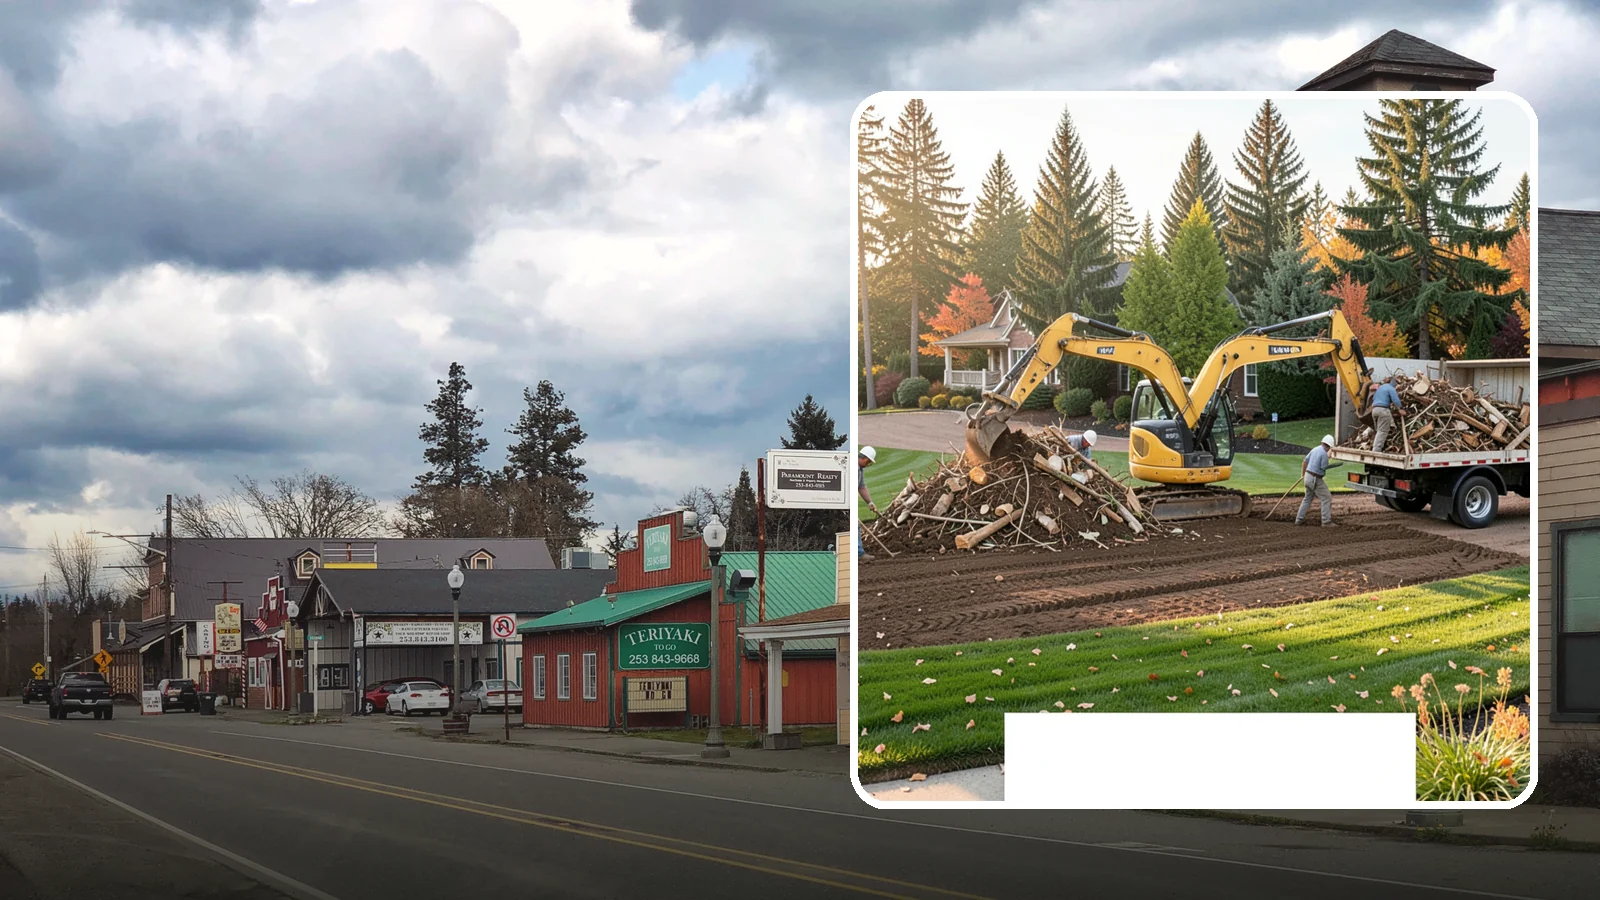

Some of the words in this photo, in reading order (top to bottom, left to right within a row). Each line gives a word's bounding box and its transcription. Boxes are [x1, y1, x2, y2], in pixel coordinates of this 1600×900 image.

[781, 471, 815, 479] PARAMOUNT
[817, 472, 839, 480] REALTY
[624, 627, 702, 646] TERIYAKI
[629, 654, 649, 664] 253
[651, 654, 700, 664] 843-9668
[639, 681, 673, 691] TERIYAKI
